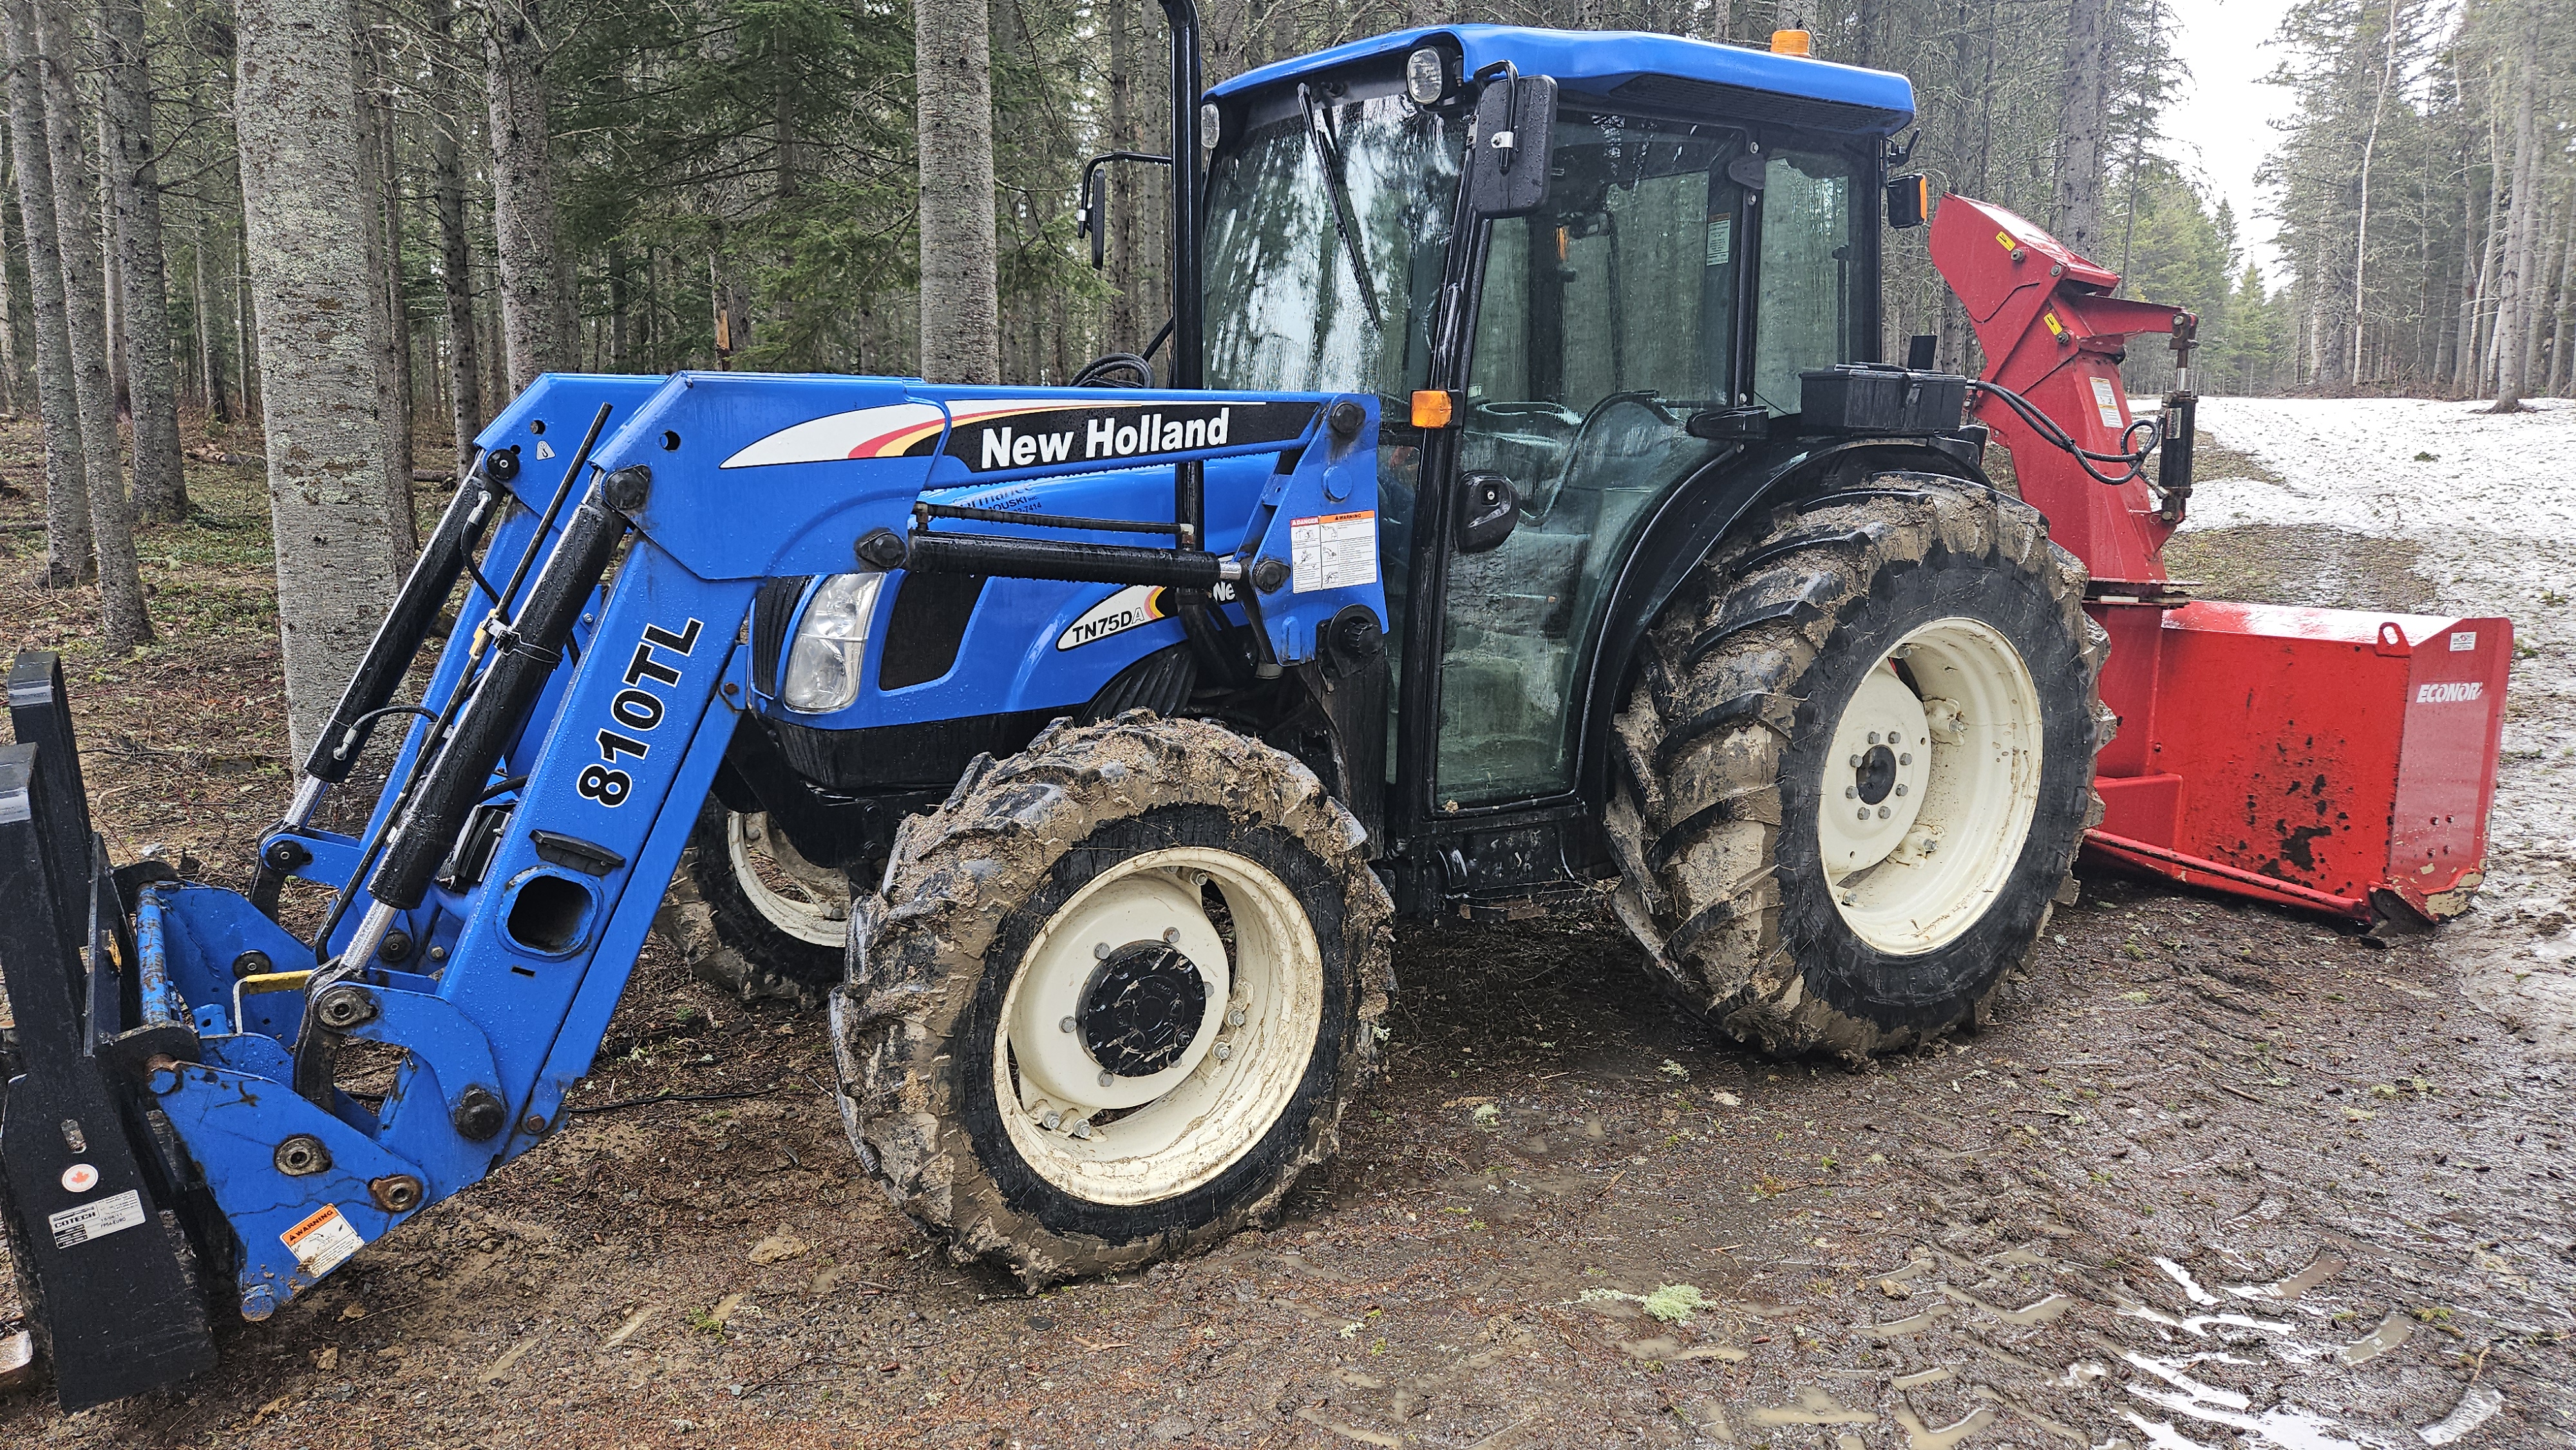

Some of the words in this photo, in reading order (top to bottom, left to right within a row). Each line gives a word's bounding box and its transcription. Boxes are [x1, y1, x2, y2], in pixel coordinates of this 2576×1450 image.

[981, 426, 1075, 469] New
[1085, 407, 1230, 458] Holland
[1072, 607, 1145, 643] TN75DA
[2416, 683, 2481, 703] ECONOR
[576, 616, 705, 808] 810TL
[54, 1211, 96, 1229] COTECH
[295, 1209, 334, 1237] WARNING
